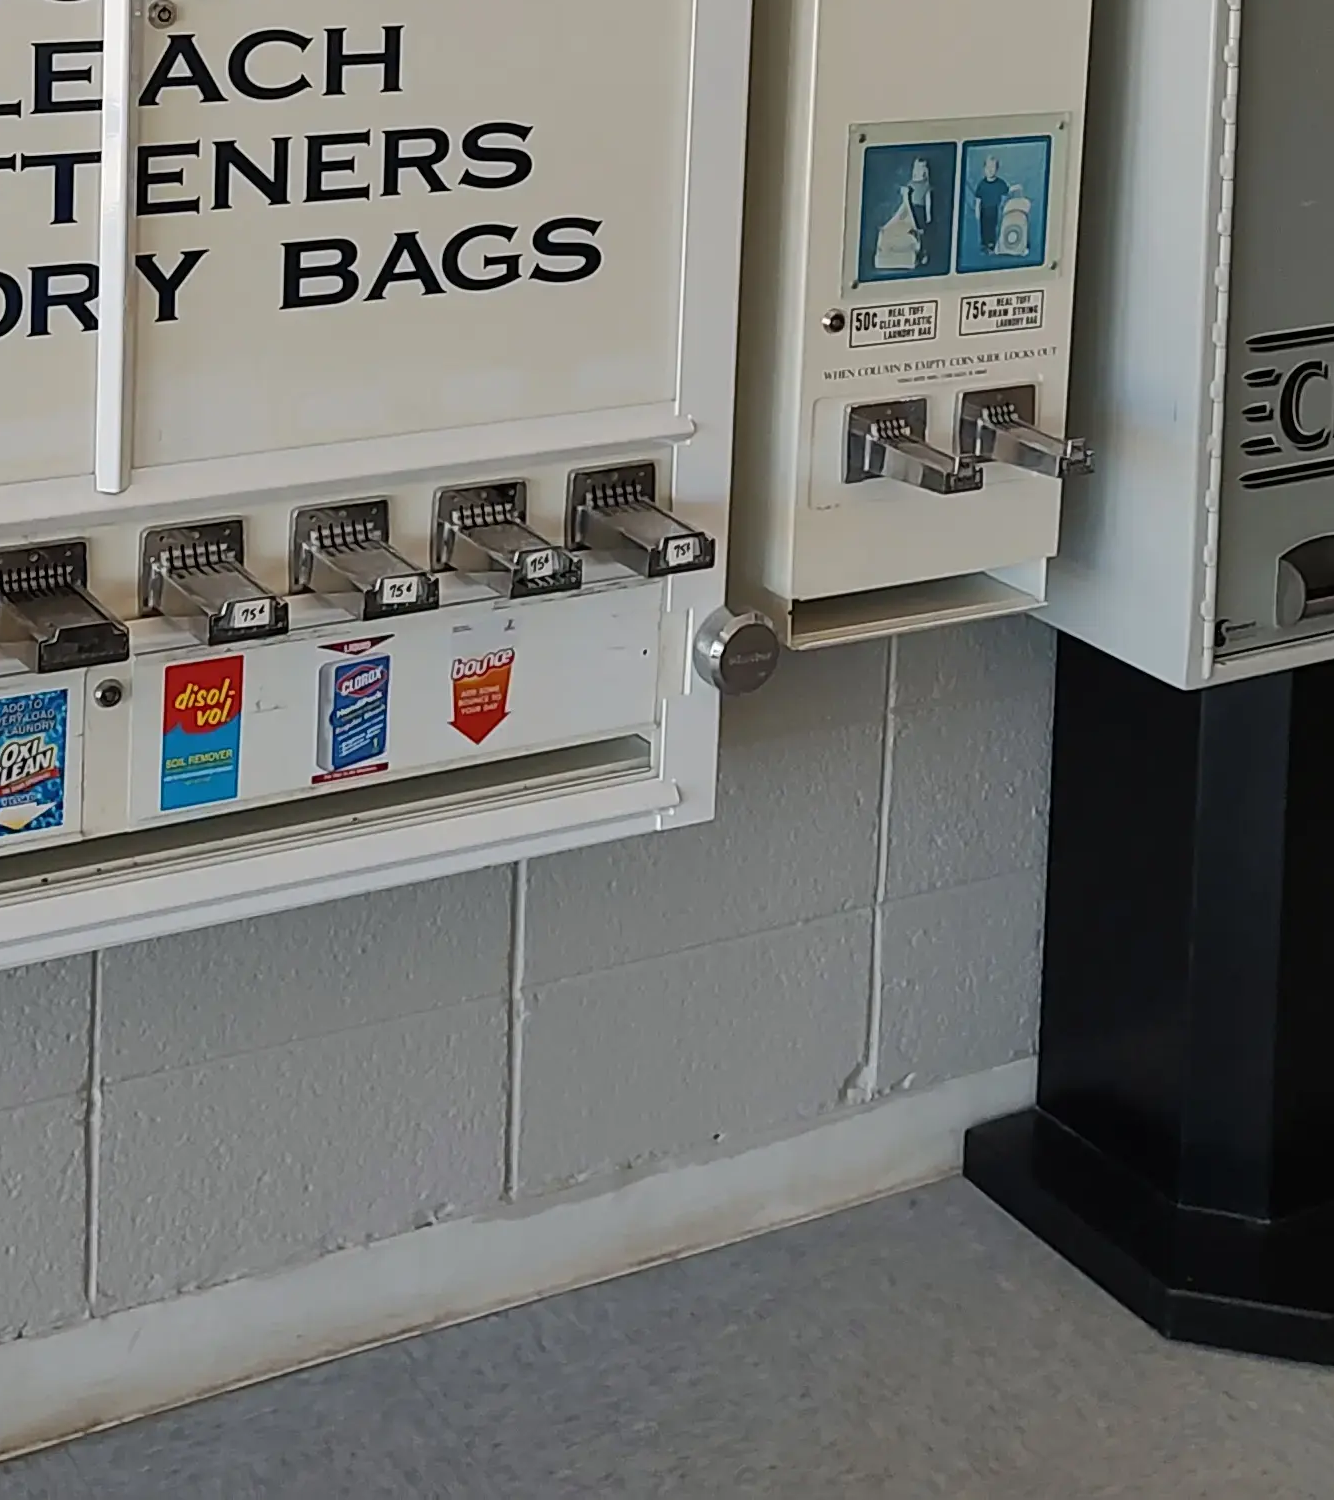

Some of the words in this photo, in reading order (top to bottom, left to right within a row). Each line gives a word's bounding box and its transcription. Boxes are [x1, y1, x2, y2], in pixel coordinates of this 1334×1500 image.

[279, 218, 603, 310] BAGS
[996, 297, 1013, 307] REAL
[888, 307, 905, 318] REAL
[908, 305, 925, 316] TUFF
[879, 319, 901, 330] CLEAR
[903, 315, 933, 328] PLASTIC
[995, 317, 1025, 329] LAUNDRY
[1025, 315, 1038, 325] BAG
[883, 328, 916, 340] LAUNDRY
[917, 326, 932, 336] BAG
[823, 369, 855, 381] WHEN
[858, 363, 901, 377] COLUMN
[903, 362, 912, 372] IS
[915, 358, 946, 371] EMPTY
[949, 355, 975, 367] COIN
[976, 352, 1000, 363] SLIDE
[1004, 349, 1035, 361] LOCKS
[1037, 346, 1058, 357] OUT
[452, 648, 514, 680] bounce
[341, 665, 383, 697] CLOROX
[1, 702, 25, 714] ADD
[28, 699, 43, 710] TO
[23, 708, 55, 723] LOAD
[4, 720, 56, 737] LAUNDRY
[1, 736, 41, 768] OXI
[165, 758, 186, 769] SOIL
[188, 749, 233, 765] REMOVER
